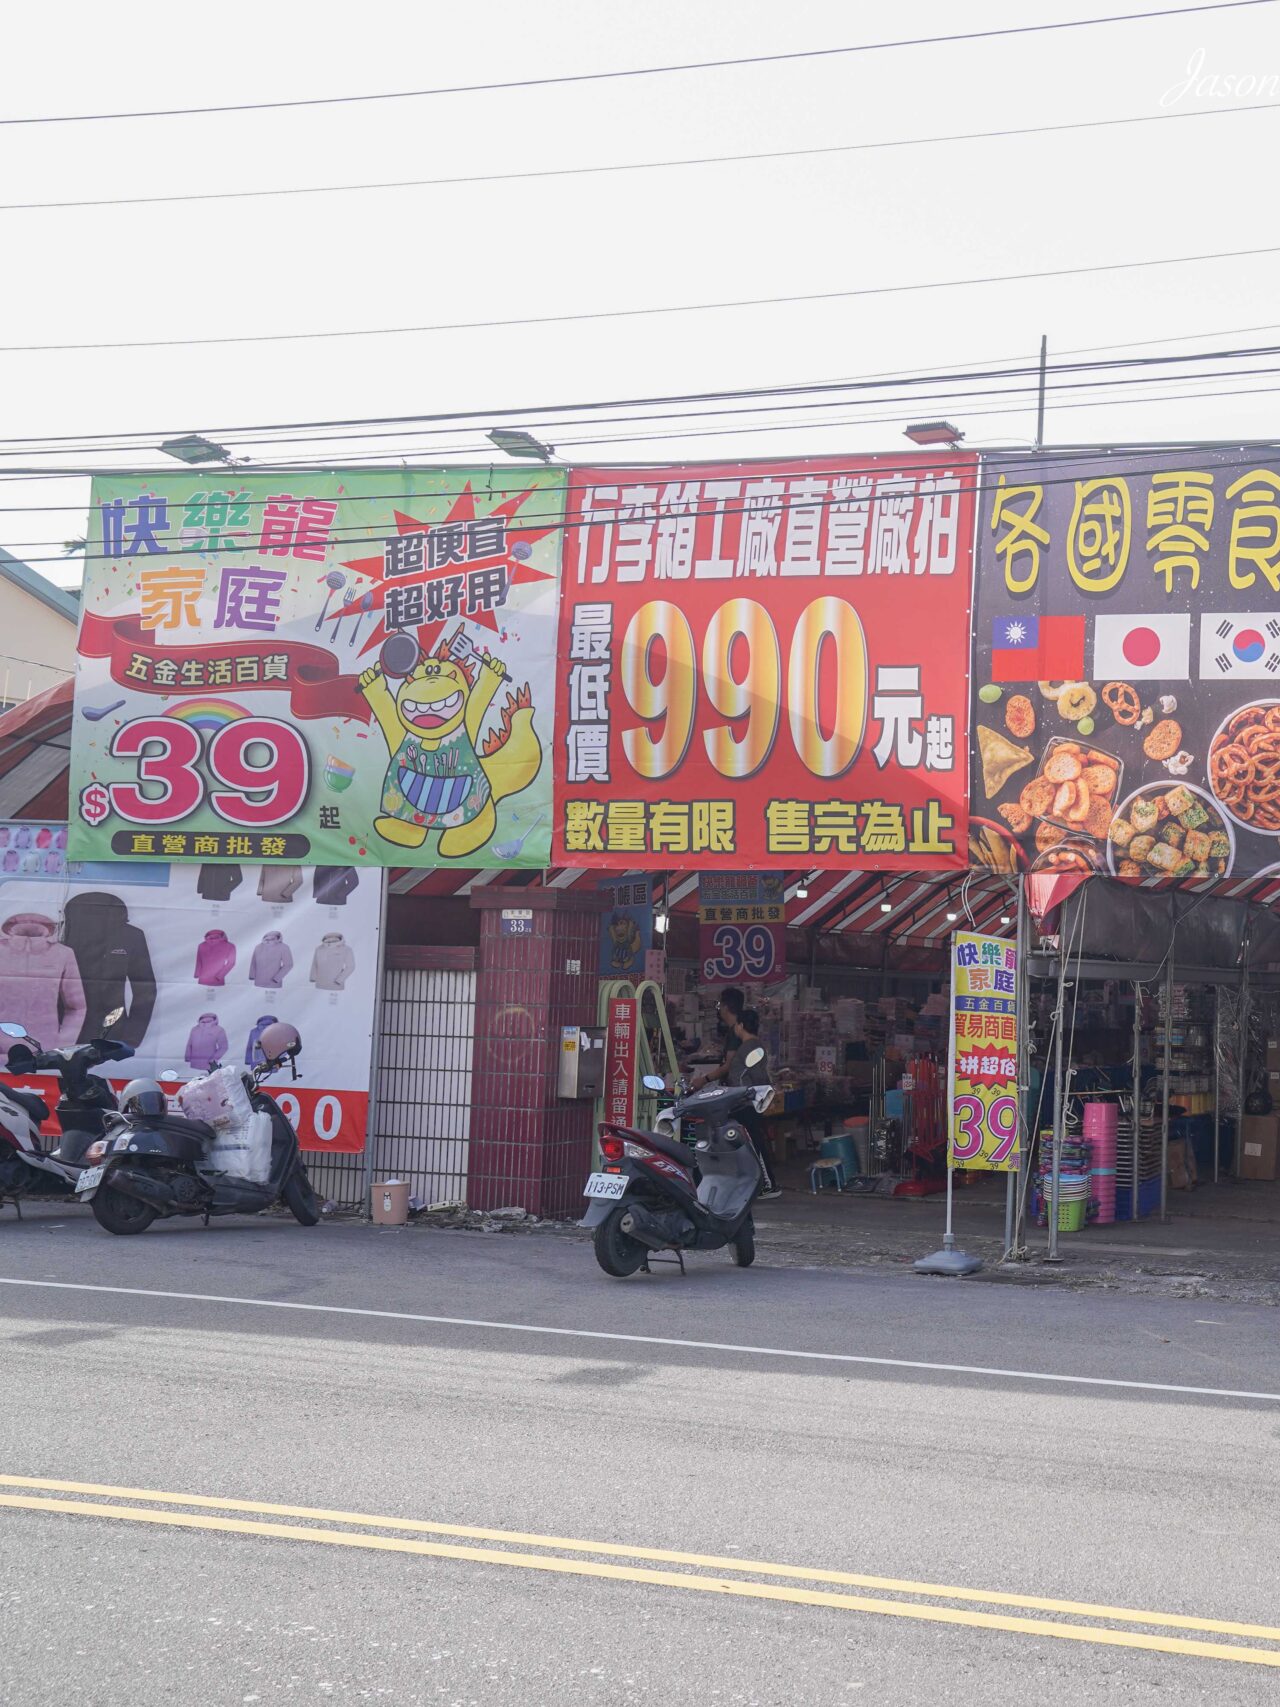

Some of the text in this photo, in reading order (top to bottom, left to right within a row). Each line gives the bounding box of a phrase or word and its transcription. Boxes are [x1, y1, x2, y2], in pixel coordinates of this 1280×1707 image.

[101, 489, 339, 563] 快樂龍
[383, 516, 508, 580] 超便宜
[577, 472, 962, 584] 行李箱工廠直營廠拍
[139, 565, 288, 632] 家庭
[383, 566, 508, 633] 超好用
[125, 653, 290, 687] 五金生活百貨
[567, 602, 614, 783] 最低價
[620, 596, 870, 779] 990
[130, 834, 287, 857] 直營商批發
[319, 806, 342, 830] 起
[564, 799, 955, 854] 數量有限 售完為止
[704, 907, 781, 921] 直營商批發
[968, 968, 1015, 994] 家庭
[953, 1094, 1018, 1162] 39
